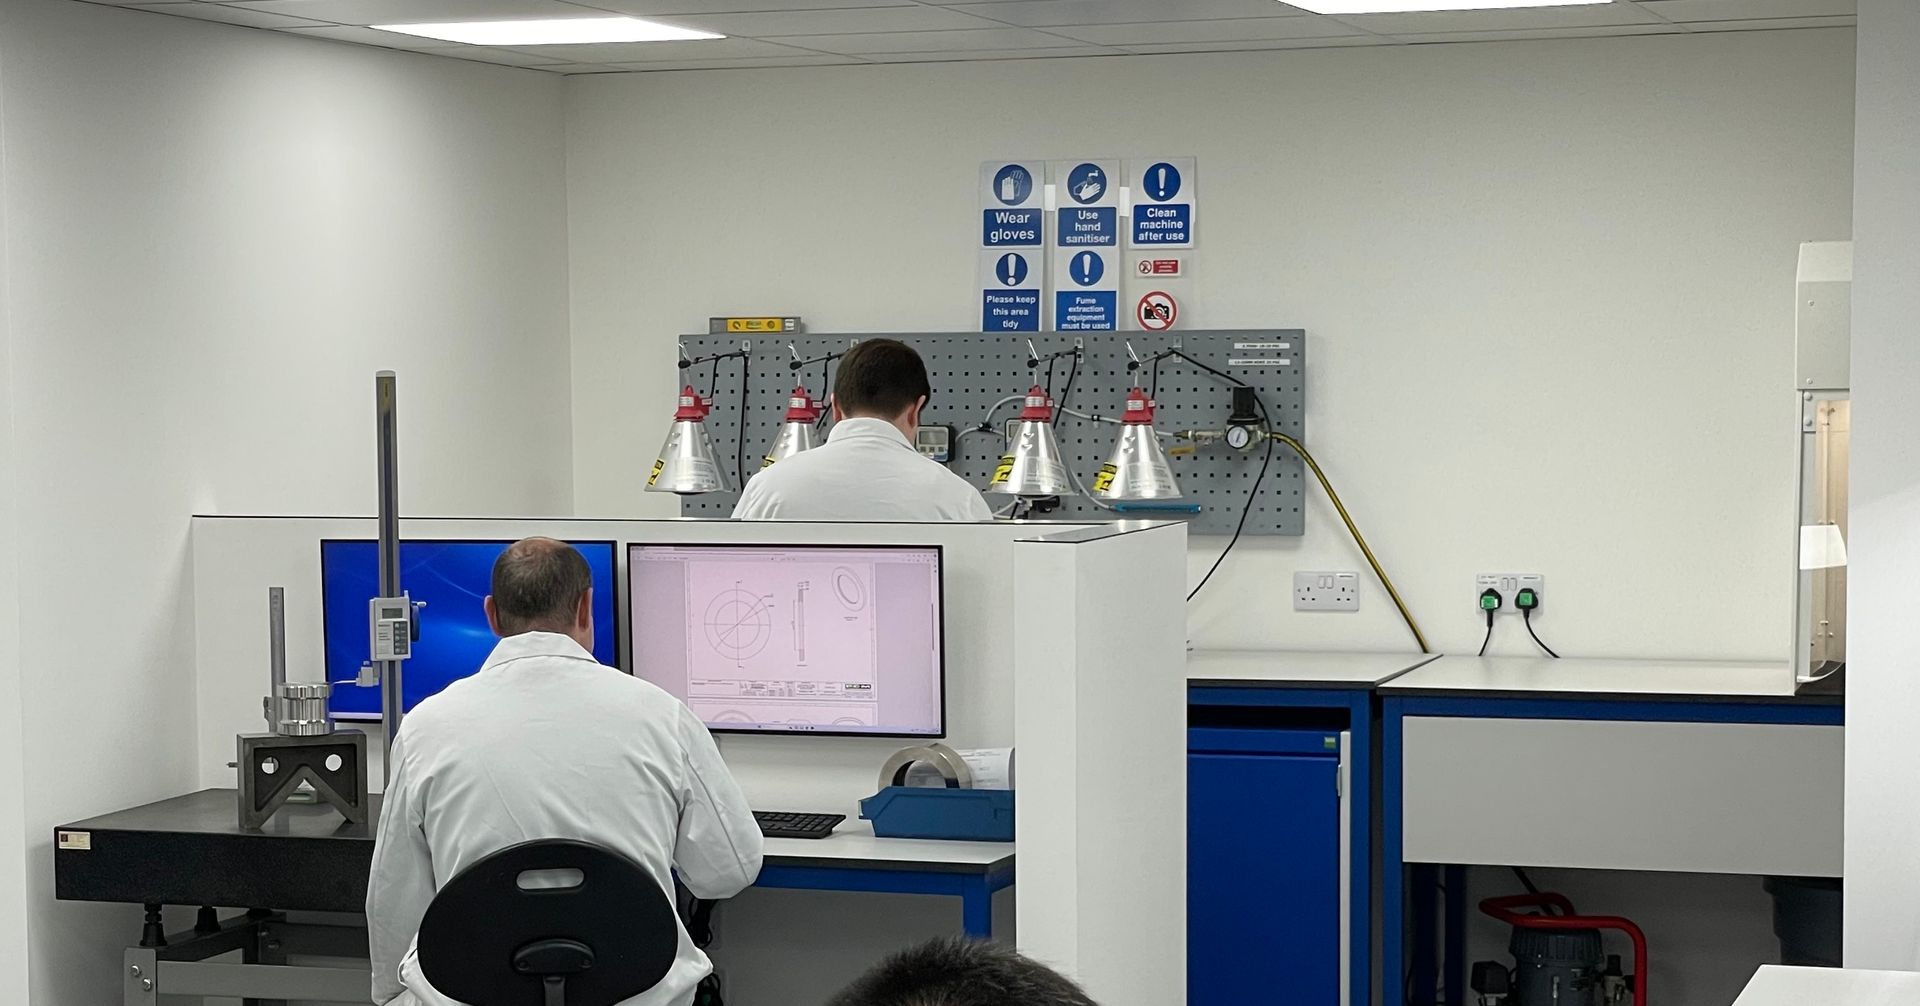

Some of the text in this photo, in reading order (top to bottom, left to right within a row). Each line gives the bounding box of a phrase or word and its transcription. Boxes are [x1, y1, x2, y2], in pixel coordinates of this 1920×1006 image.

[1078, 210, 1098, 220] Use
[1147, 208, 1177, 218] Clean
[995, 212, 1030, 224] Wear
[1075, 222, 1101, 231] hand
[1140, 220, 1184, 229] machine
[990, 228, 1035, 243] gloves
[1065, 234, 1110, 243] sanitiser
[1138, 231, 1185, 241] after use
[986, 295, 1036, 304] Please keep
[1075, 296, 1097, 304] Fume
[993, 307, 1009, 316] this
[1068, 305, 1104, 313] extraction
[1066, 314, 1105, 322] equipment
[1002, 319, 1019, 330] tidy
[1061, 322, 1111, 330] must be used
